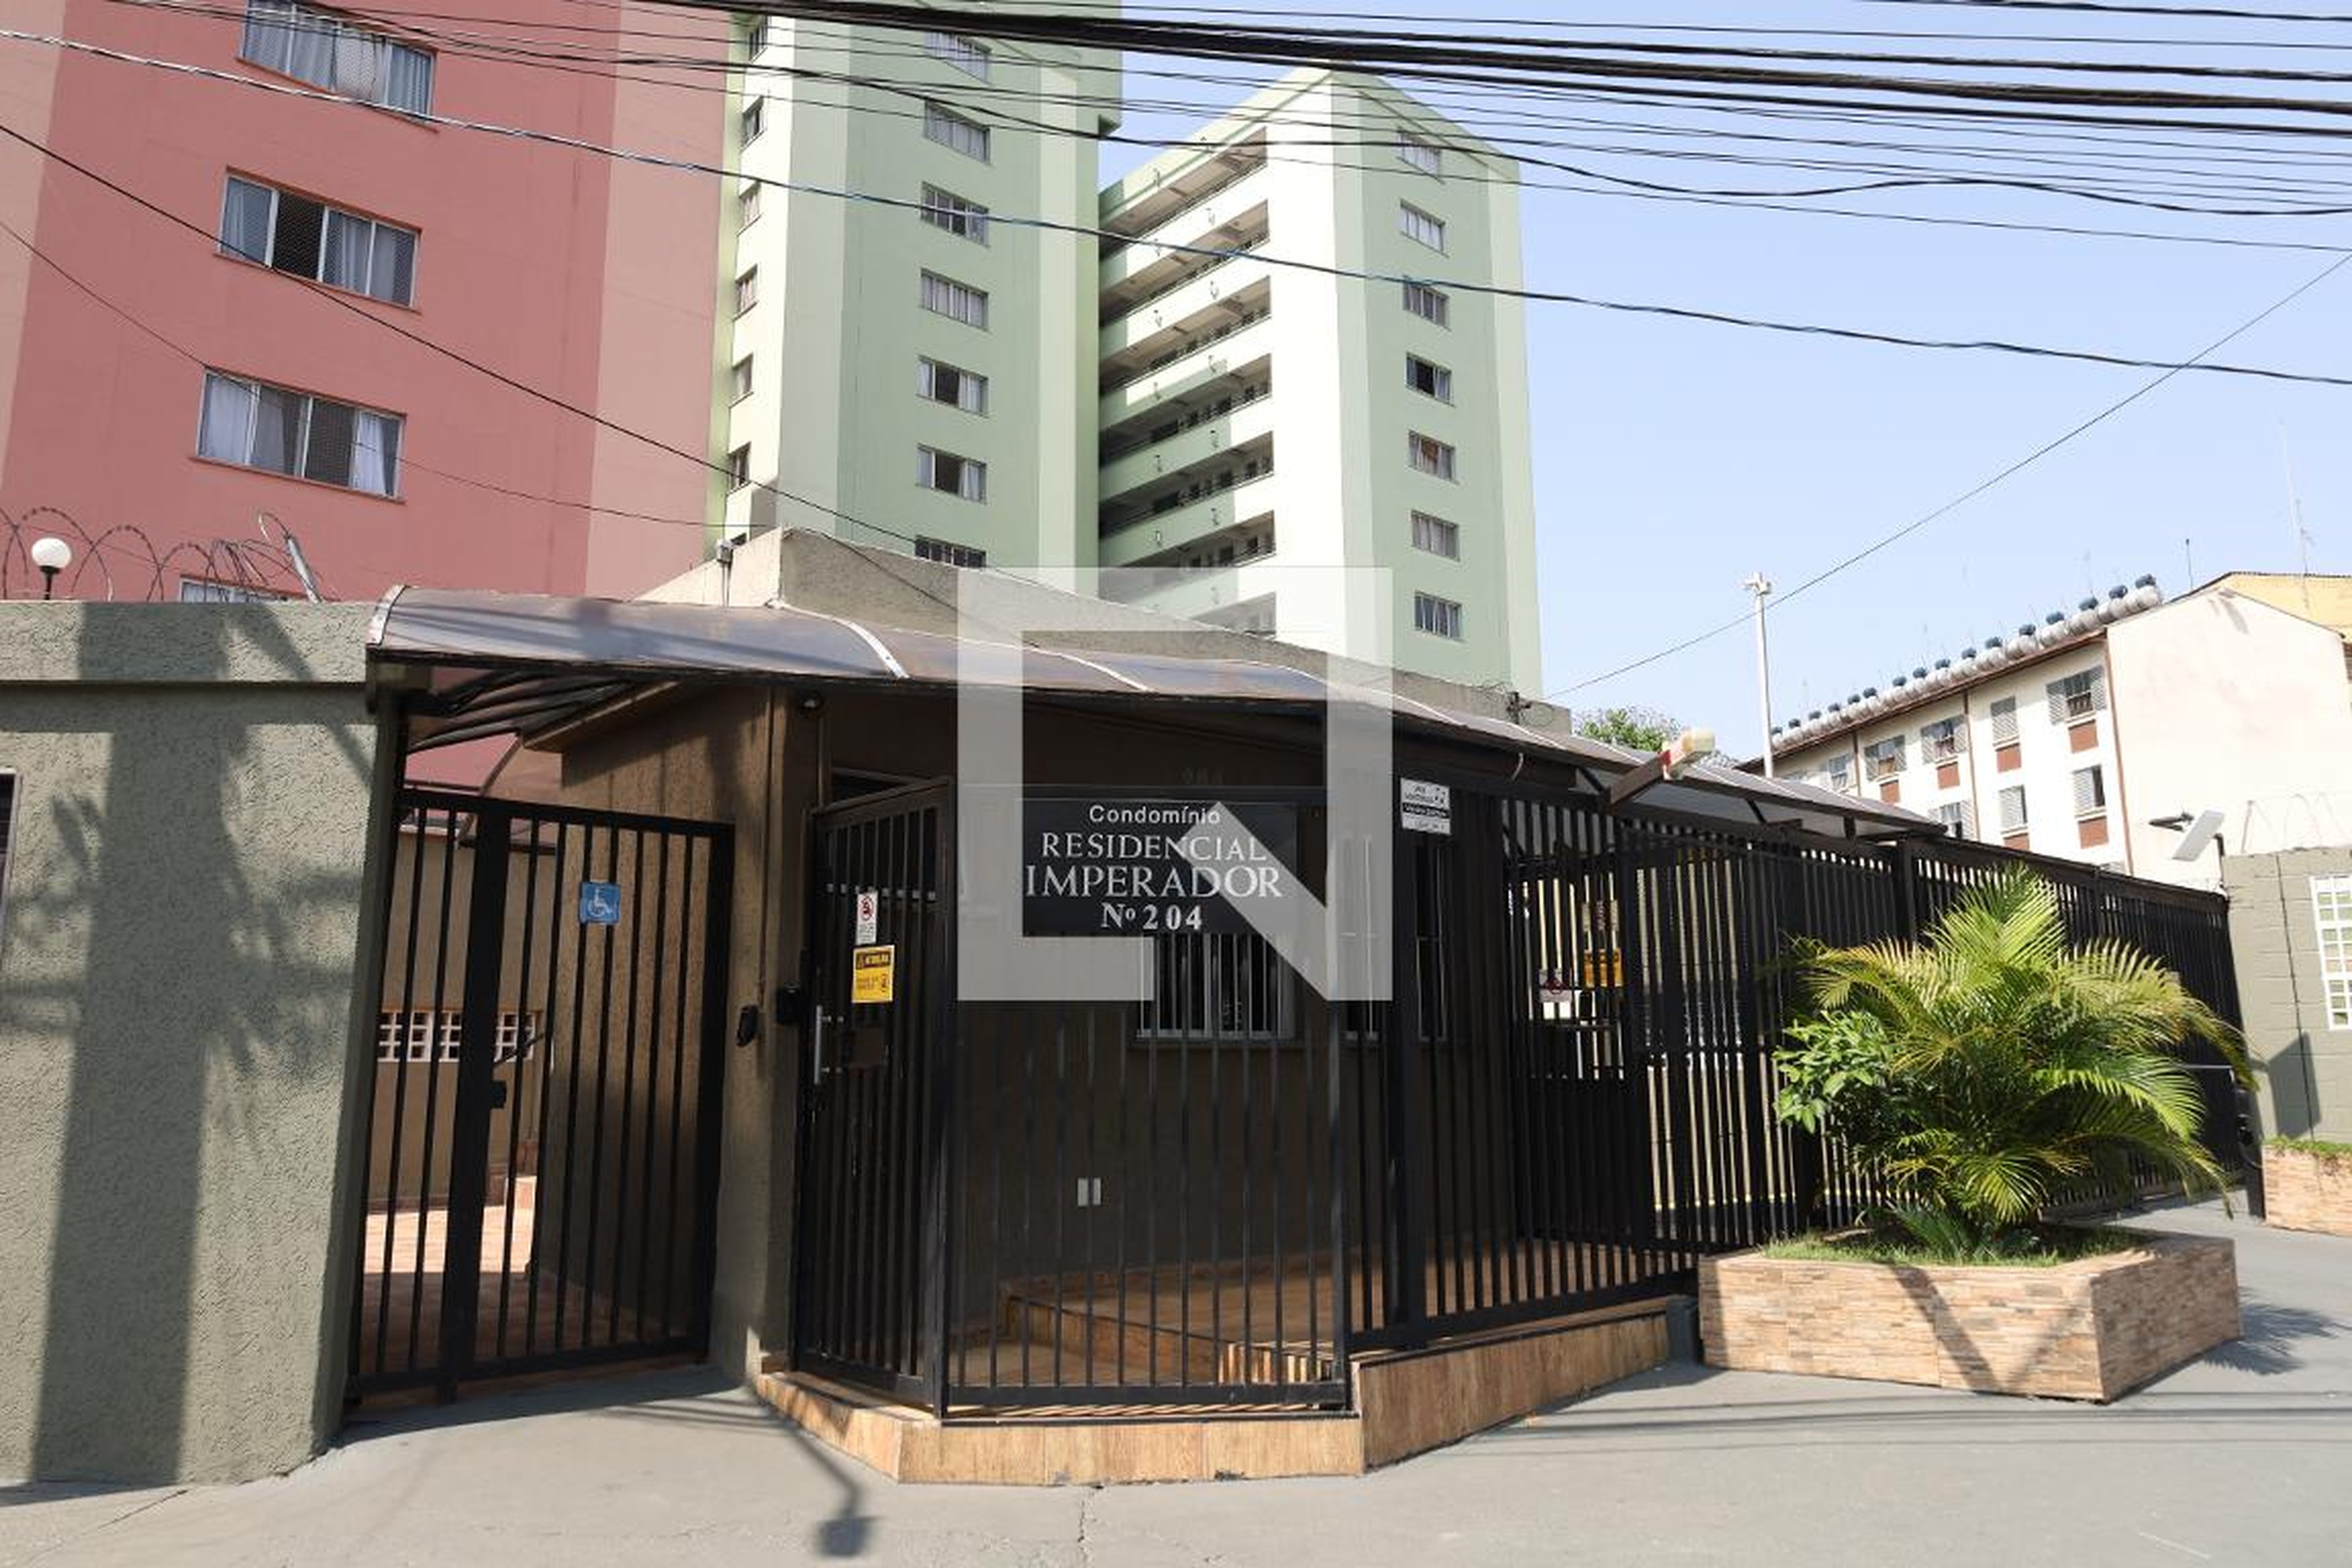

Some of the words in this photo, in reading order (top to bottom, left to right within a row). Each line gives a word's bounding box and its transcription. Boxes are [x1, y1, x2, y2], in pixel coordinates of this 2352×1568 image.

[1089, 805, 1221, 824] Condomínio
[1042, 832, 1267, 861] RESIDENCIAL
[1025, 865, 1283, 897] IMPERADOR
[1142, 904, 1202, 930] 204
